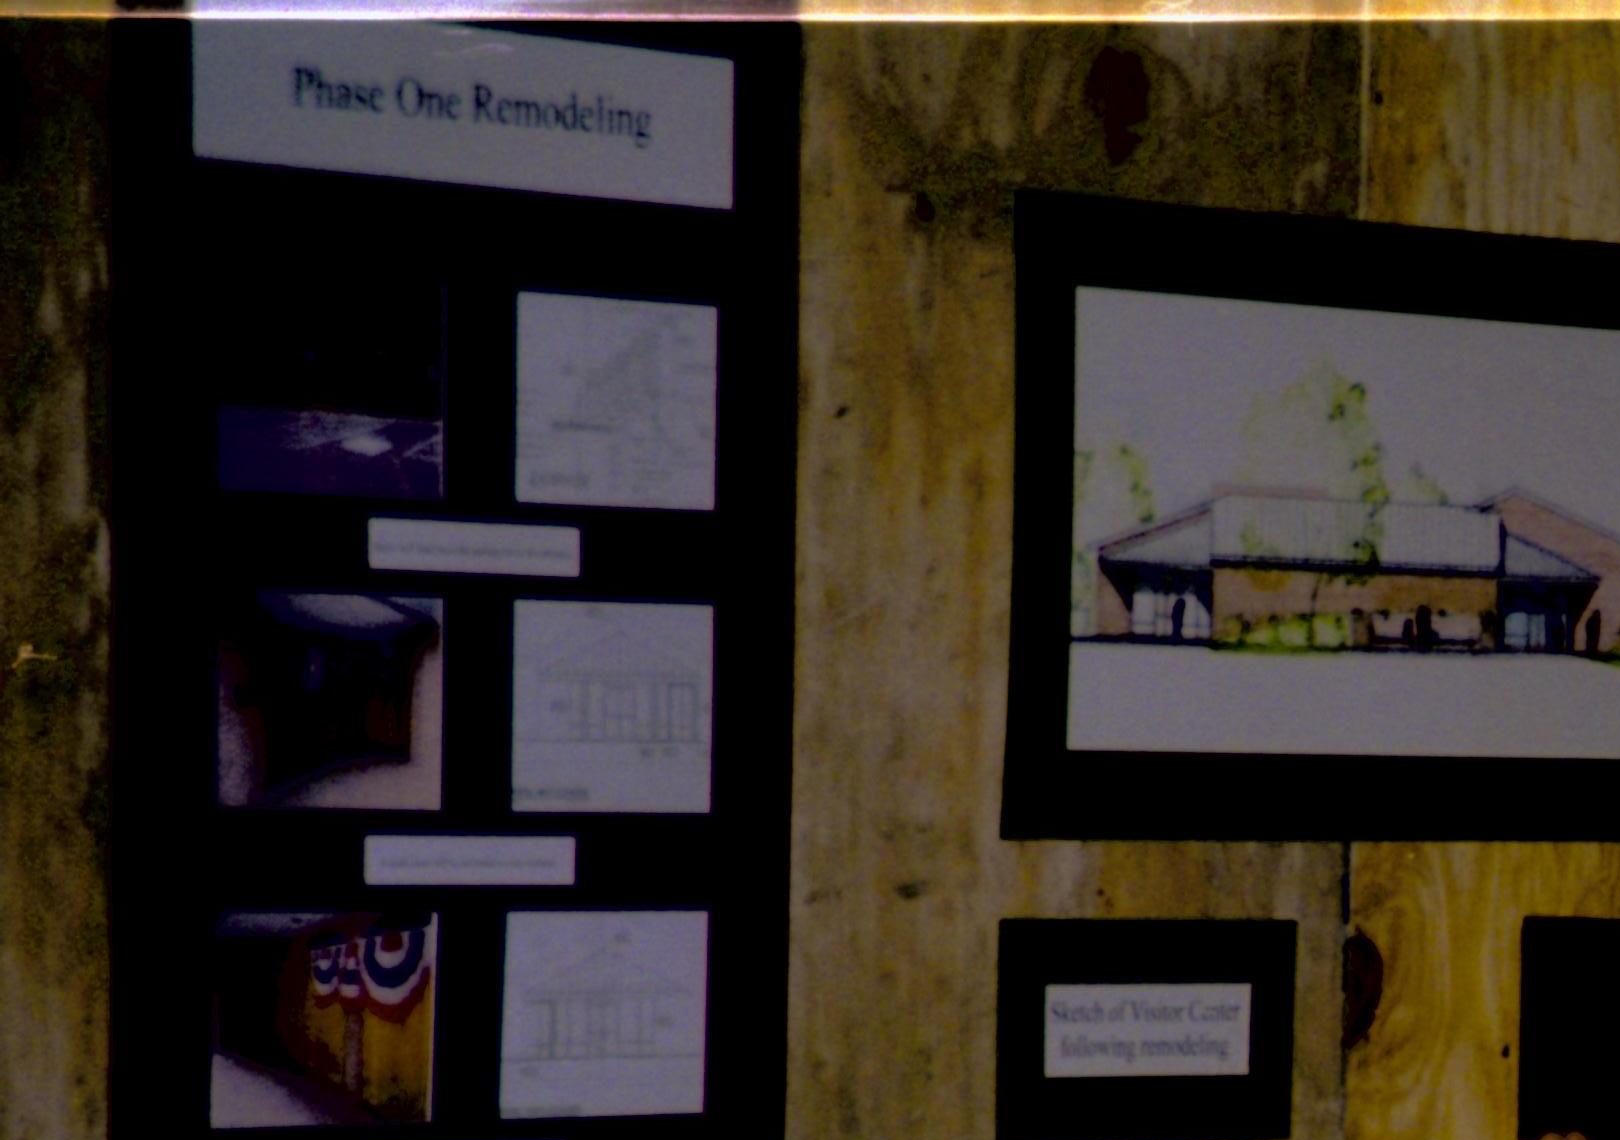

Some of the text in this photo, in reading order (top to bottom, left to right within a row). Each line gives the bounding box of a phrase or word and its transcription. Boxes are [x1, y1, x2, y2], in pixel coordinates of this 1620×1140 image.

[292, 66, 651, 148] Phase One Remodeling
[1051, 998, 1241, 1024] Sketch of Visitor Center
[1060, 1034, 1230, 1064] following remodeling
